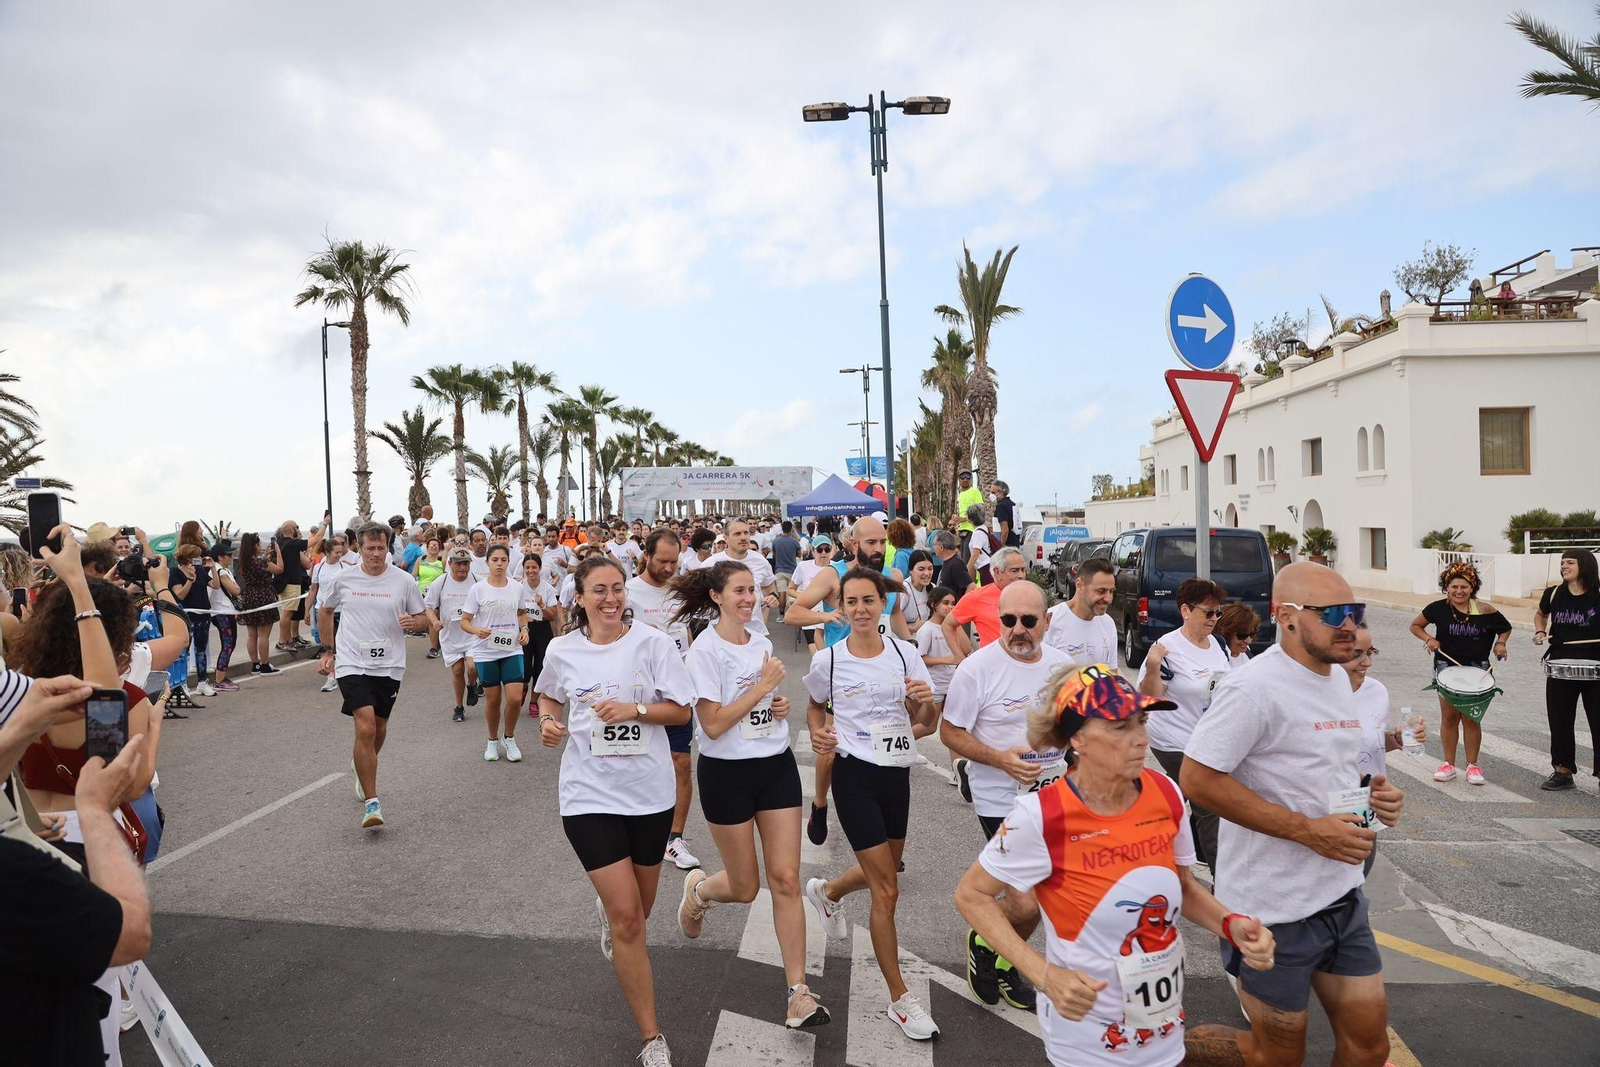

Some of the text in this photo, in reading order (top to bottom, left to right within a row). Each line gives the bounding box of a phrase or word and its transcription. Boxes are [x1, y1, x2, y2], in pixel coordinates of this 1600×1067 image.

[682, 472, 694, 480] 3A
[695, 472, 738, 480] CARRERA
[805, 504, 865, 512] info@dorsalchip.es
[493, 636, 512, 646] 868
[370, 648, 385, 658] 52
[750, 708, 773, 726] 528
[603, 724, 641, 741] 529
[882, 736, 910, 752] 746
